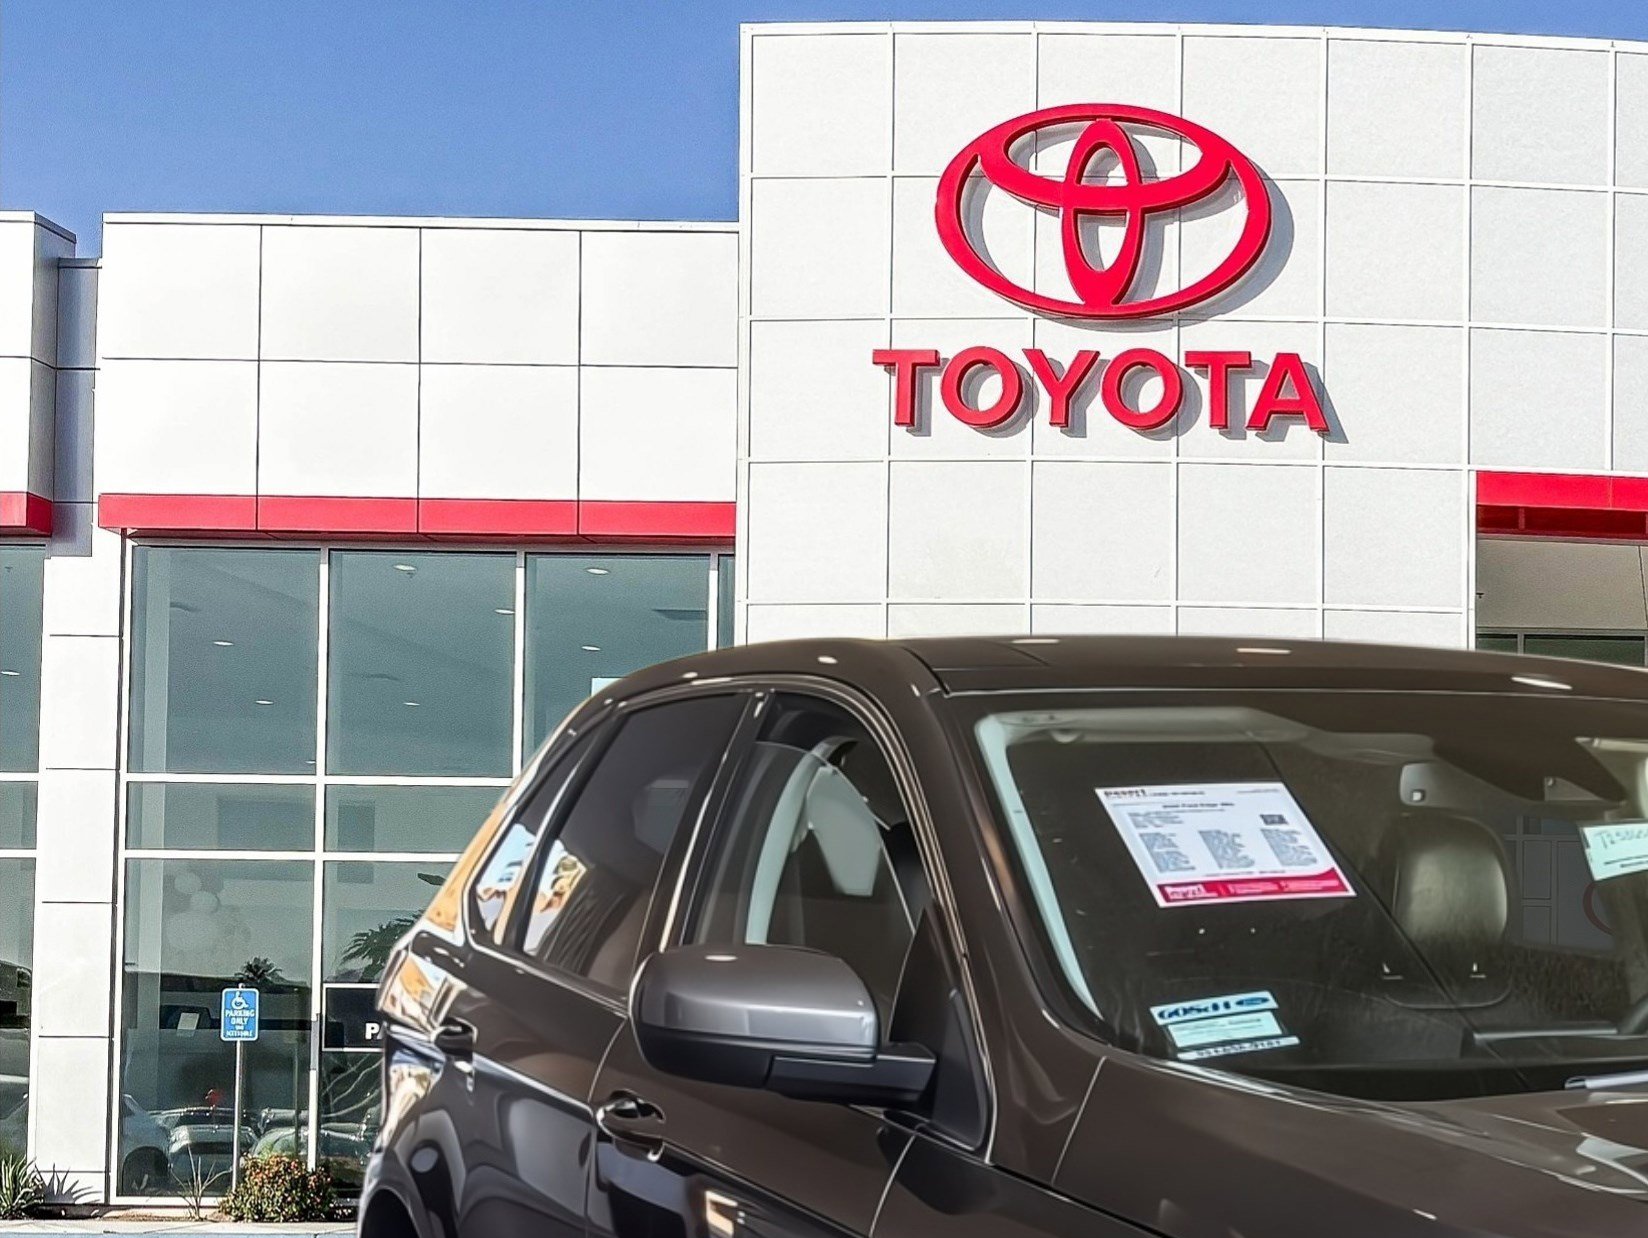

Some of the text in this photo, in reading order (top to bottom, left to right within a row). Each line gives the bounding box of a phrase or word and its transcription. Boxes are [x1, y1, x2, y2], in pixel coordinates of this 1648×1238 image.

[873, 345, 1329, 433] TOYOTA
[225, 1009, 255, 1017] PARKING
[230, 1017, 248, 1025] ONLY
